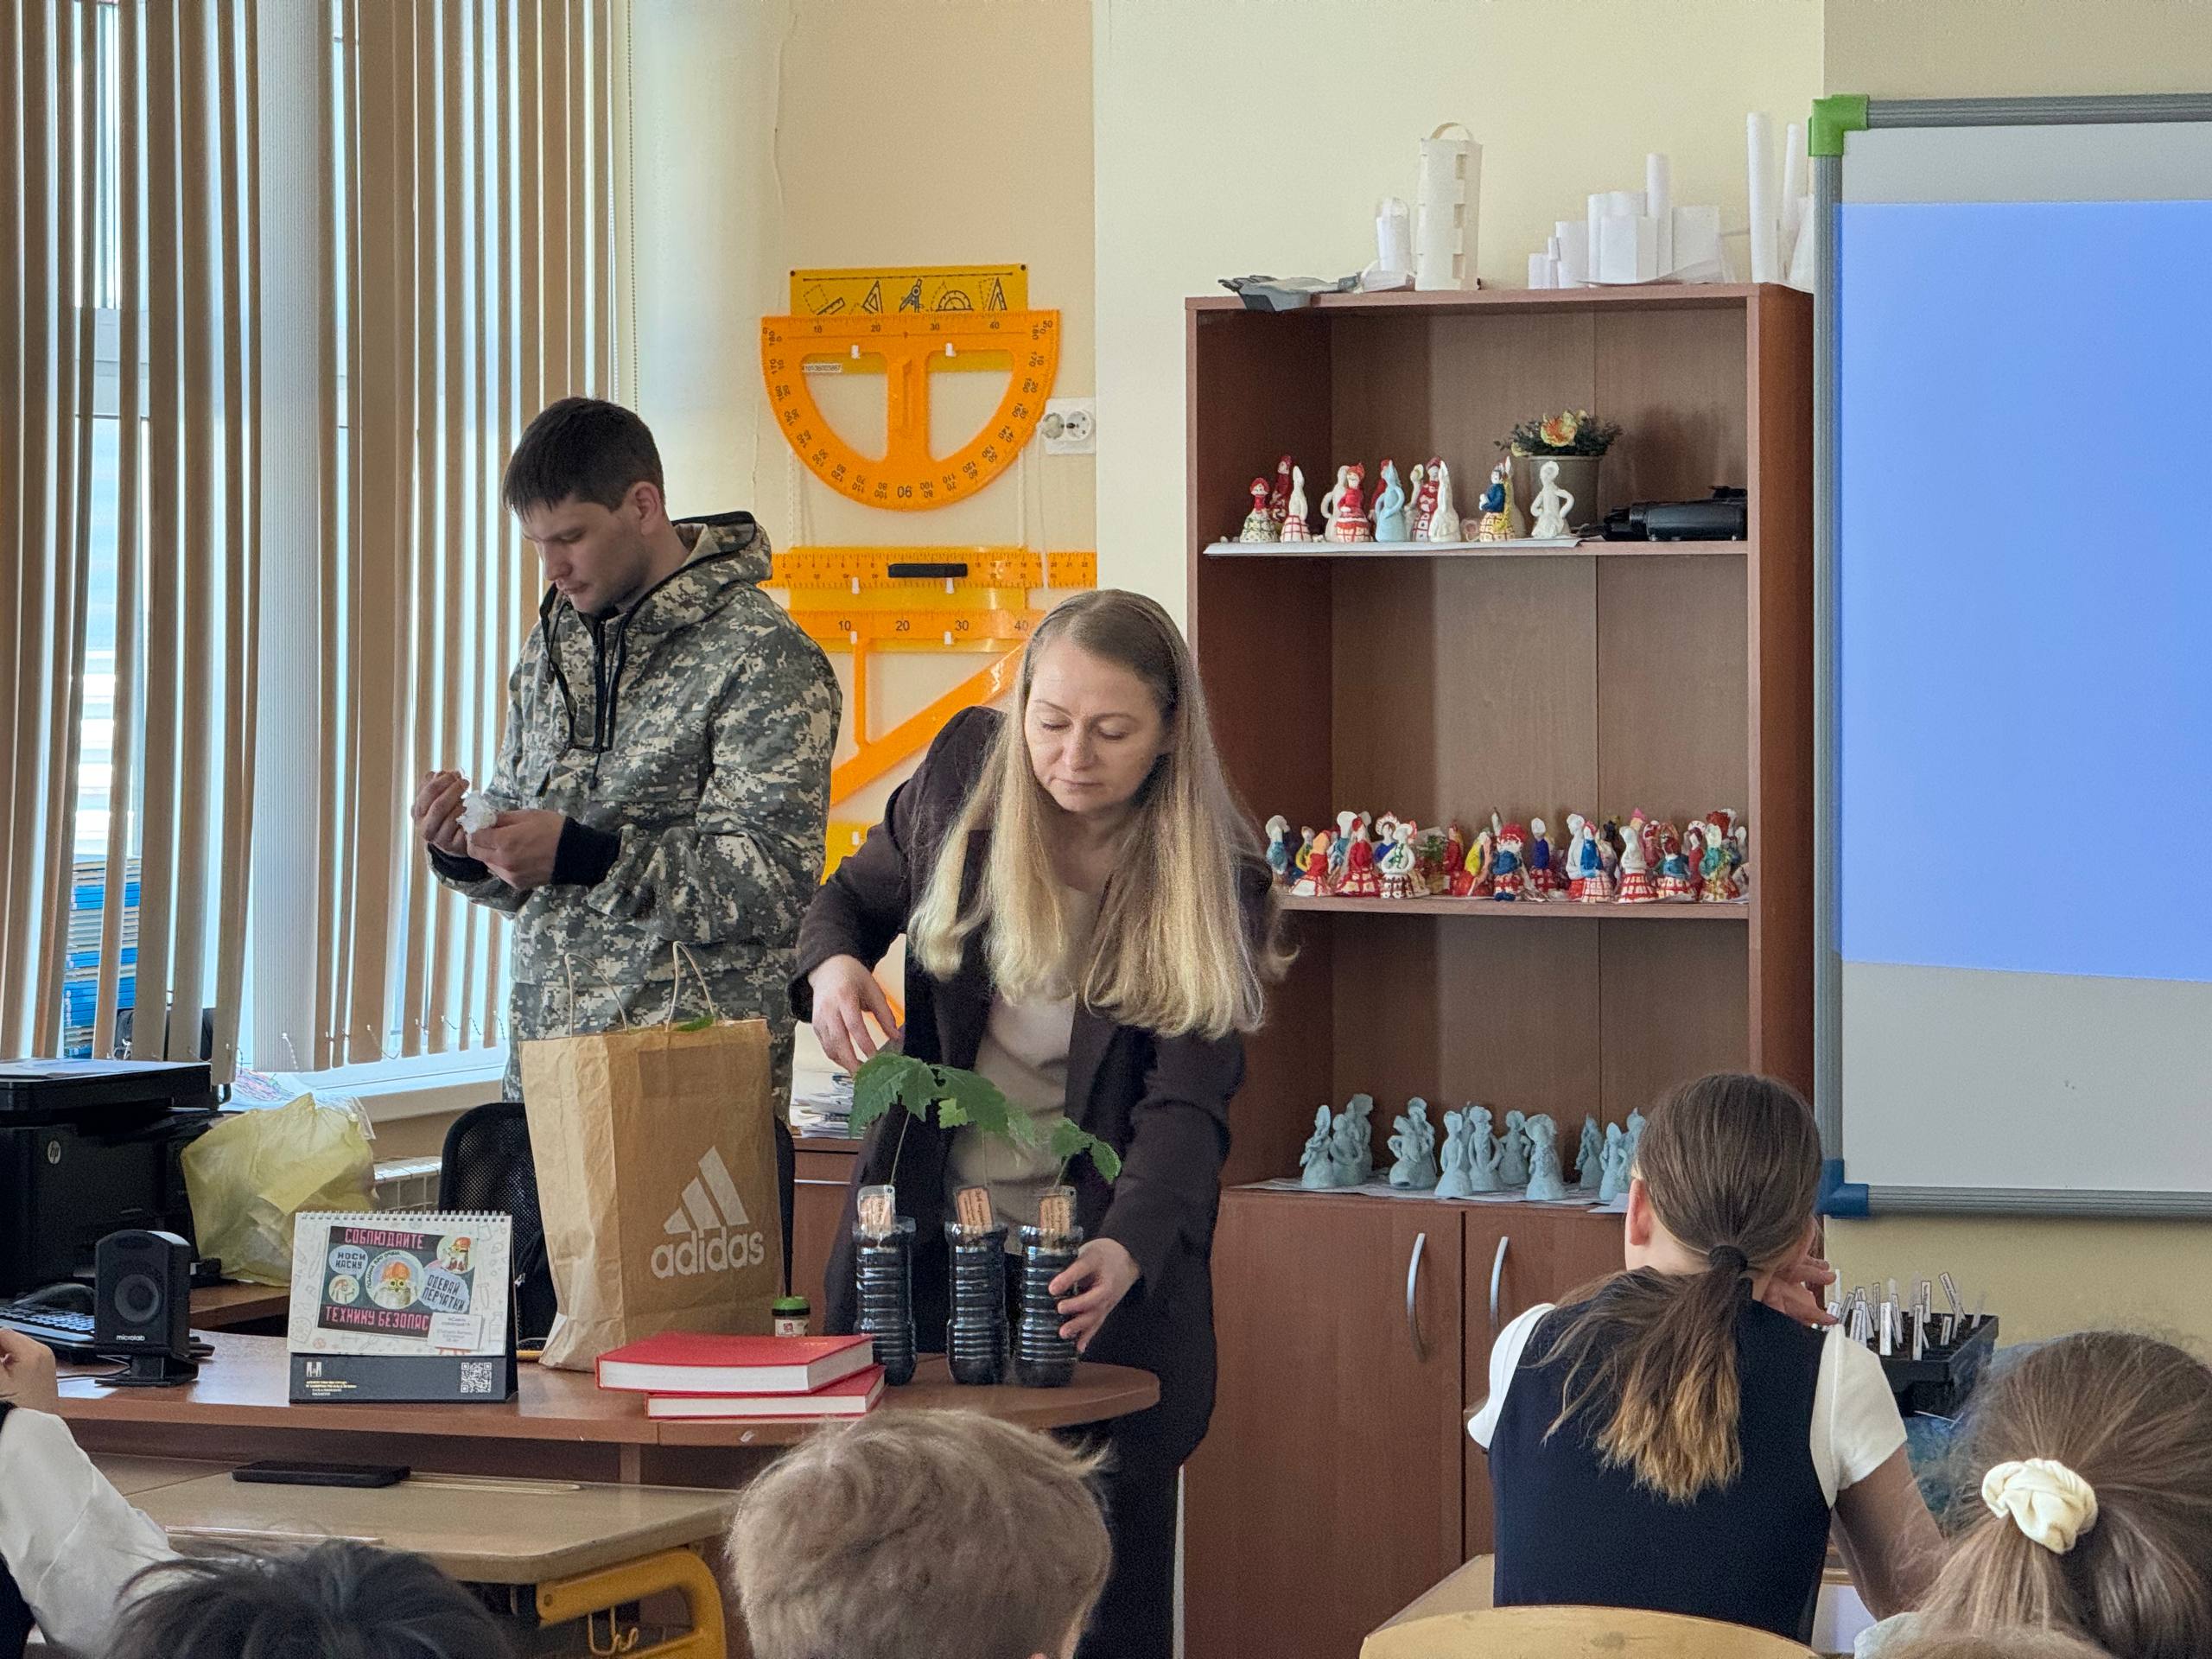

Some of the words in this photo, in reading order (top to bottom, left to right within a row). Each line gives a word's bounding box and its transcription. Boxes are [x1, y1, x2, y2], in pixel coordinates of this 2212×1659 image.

[871, 324, 880, 333] 20
[931, 322, 940, 331] 30
[990, 321, 1000, 330] 40
[897, 486, 912, 498] 90
[839, 620, 851, 632] 10
[896, 620, 911, 632] 20
[955, 620, 969, 632] 30
[1014, 620, 1029, 632] 40
[338, 1252, 366, 1261] НОСИ
[651, 1226, 765, 1279] adidas
[335, 1260, 362, 1269] КАСКУ
[422, 1287, 465, 1311] ПЕРЧАТКИ
[325, 1306, 375, 1325] ТЕХНИКУ
